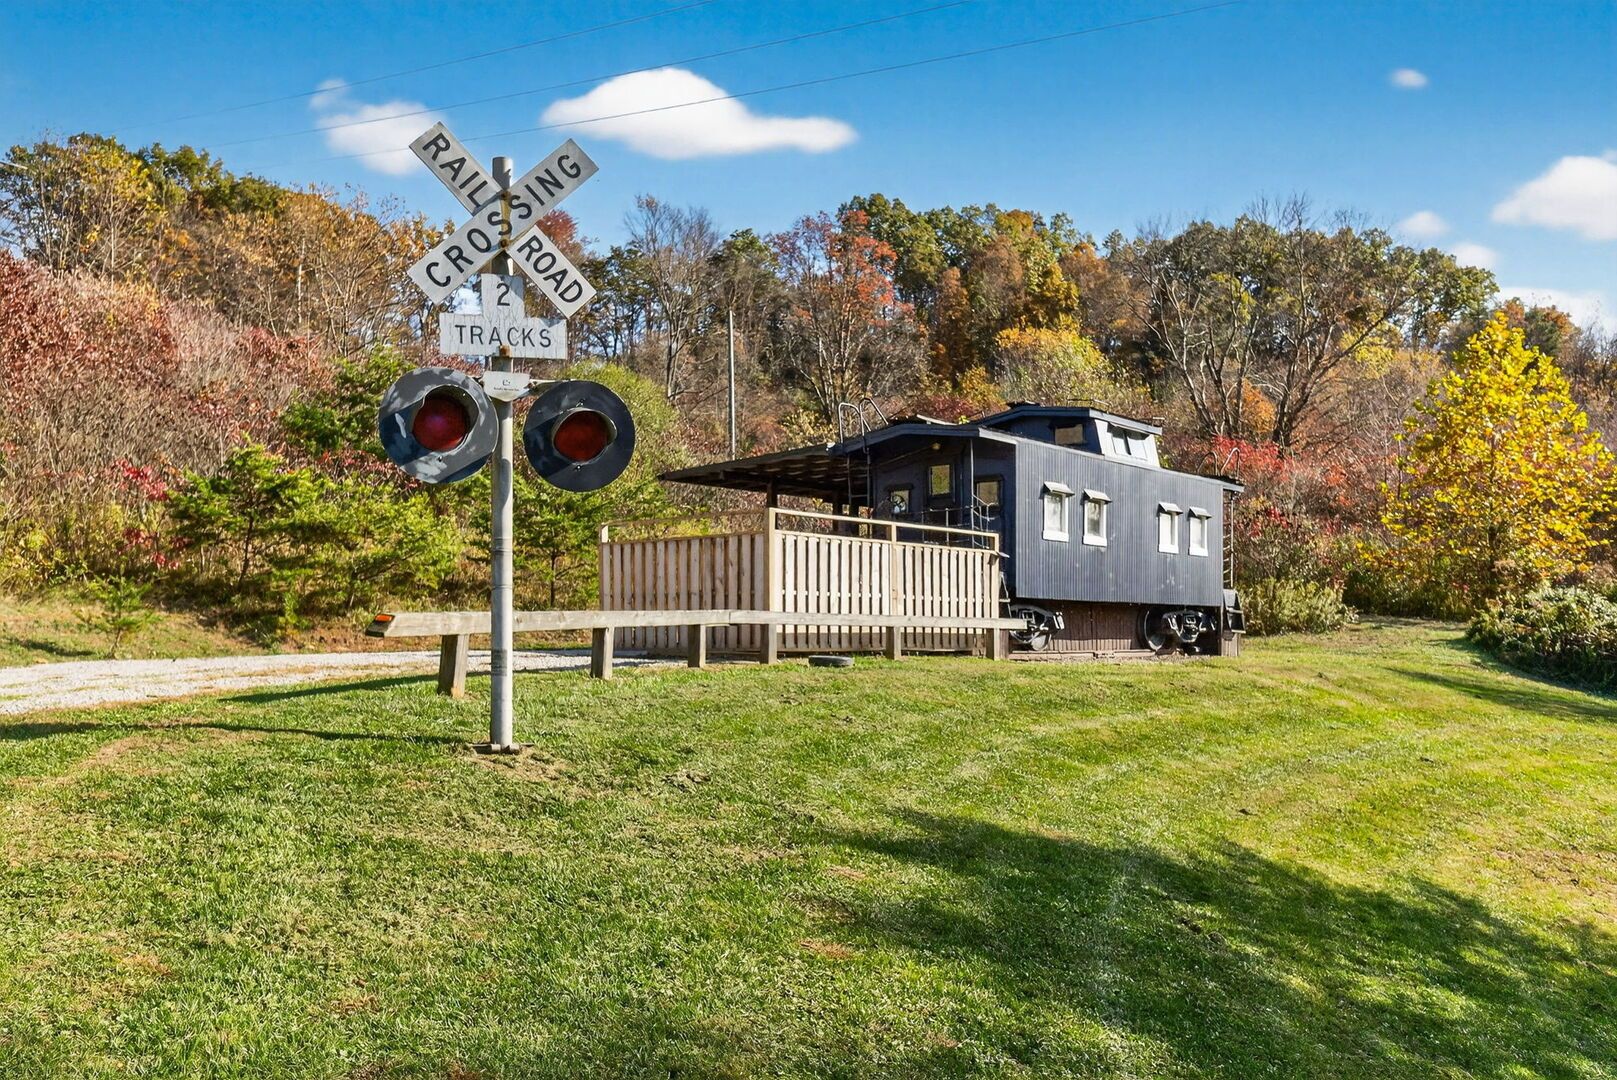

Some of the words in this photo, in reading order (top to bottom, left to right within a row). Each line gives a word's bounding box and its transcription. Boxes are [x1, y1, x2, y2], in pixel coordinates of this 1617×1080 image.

[422, 132, 489, 208] RAIL
[425, 154, 582, 288] CROSSING
[496, 282, 510, 307] 2
[516, 235, 583, 304] ROAD
[454, 324, 551, 348] TRACKS
